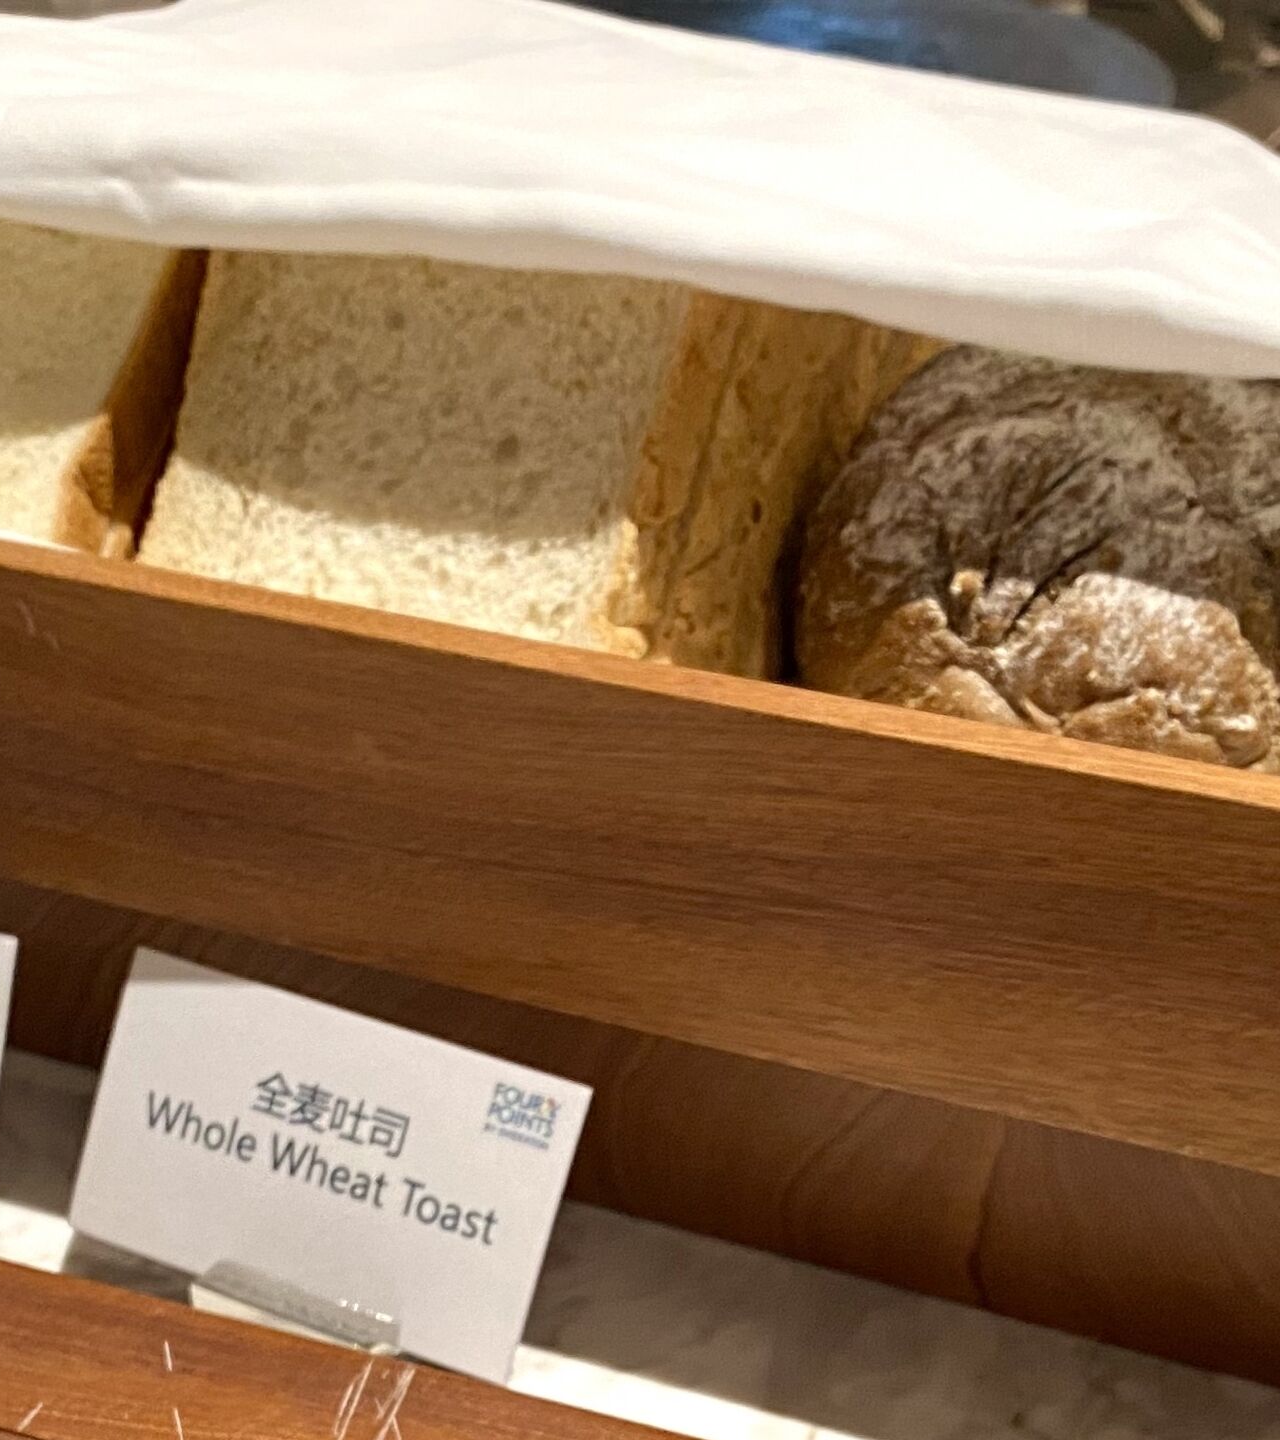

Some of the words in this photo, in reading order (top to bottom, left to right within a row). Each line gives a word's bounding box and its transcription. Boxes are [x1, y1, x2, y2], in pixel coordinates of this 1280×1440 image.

[252, 1072, 411, 1159] 全麦吐司
[487, 1102, 553, 1138] POINTS
[494, 1082, 544, 1109] FOUR
[148, 1091, 257, 1163] Whole
[271, 1133, 388, 1209] Wheat
[402, 1177, 498, 1246] Toast
